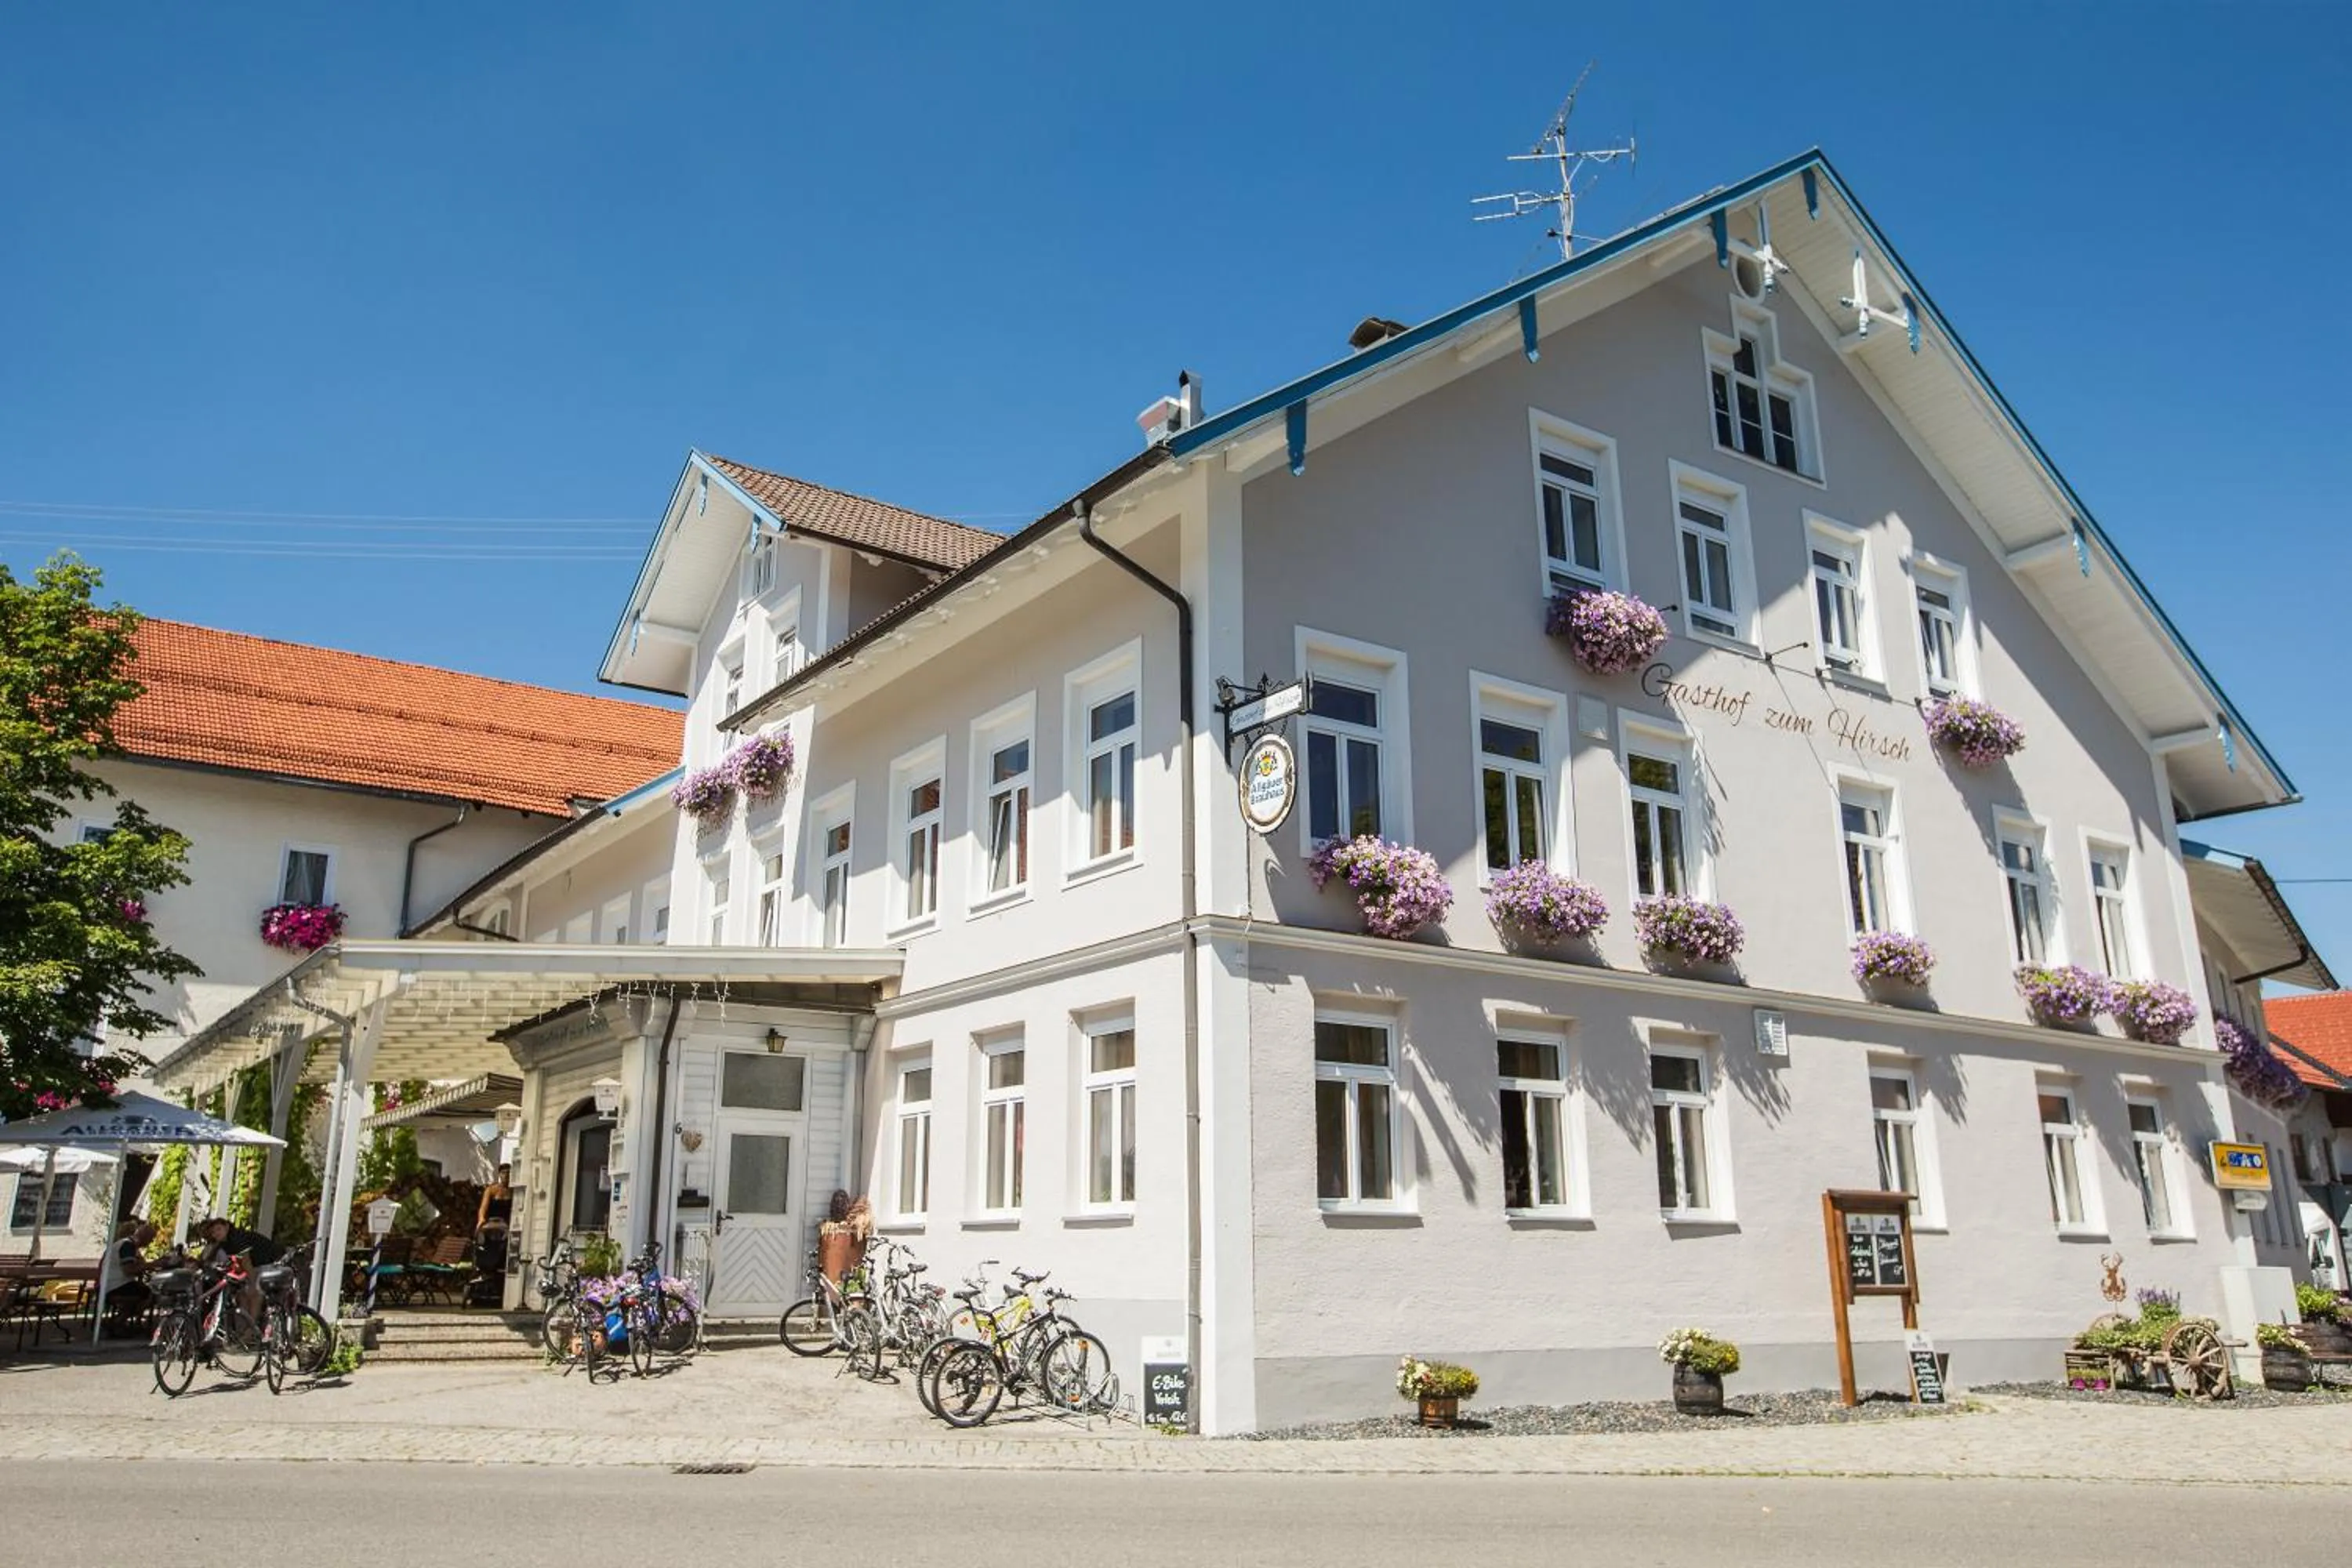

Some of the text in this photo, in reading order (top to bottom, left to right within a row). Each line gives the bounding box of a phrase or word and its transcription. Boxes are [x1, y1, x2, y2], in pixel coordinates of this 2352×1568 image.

[1641, 662, 1909, 762] Gasthof zum Hirsch
[675, 1122, 682, 1134] 6
[1152, 1374, 1185, 1390] E-Bike
